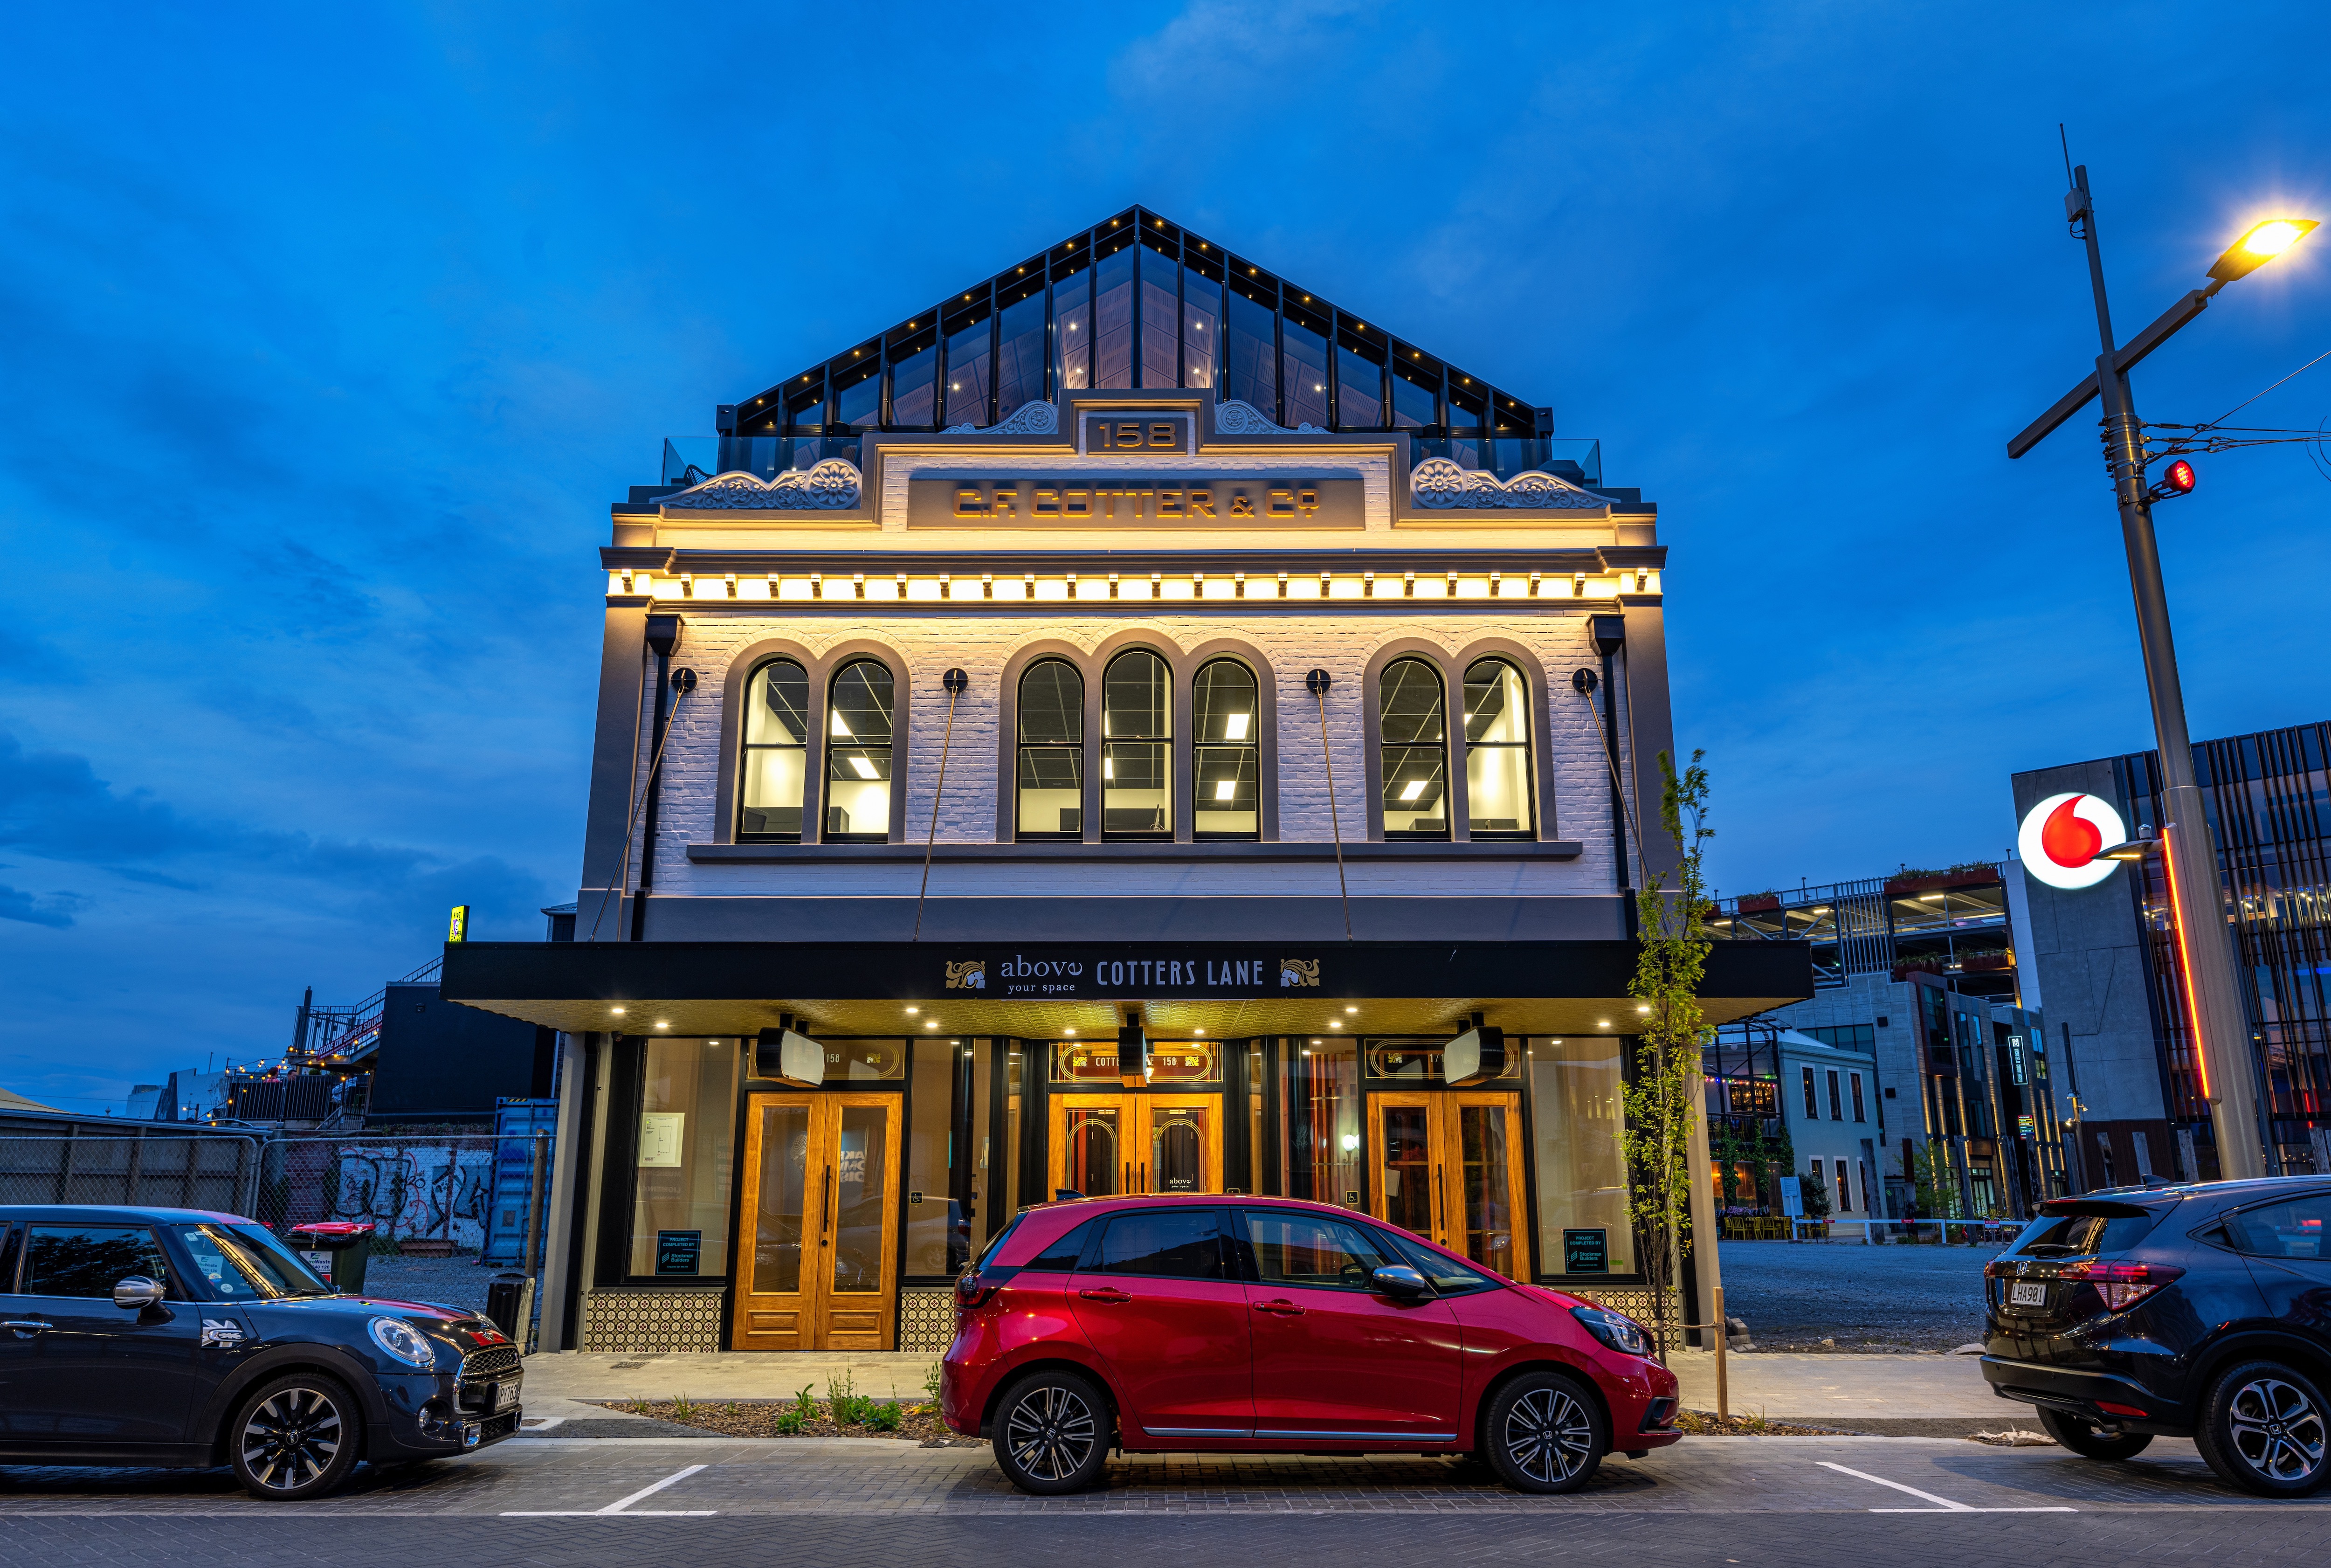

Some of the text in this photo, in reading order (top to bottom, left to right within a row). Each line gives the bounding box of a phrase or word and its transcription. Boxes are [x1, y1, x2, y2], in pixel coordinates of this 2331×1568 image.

[1099, 422, 1176, 447] 158
[953, 489, 1017, 518] C.F.
[1031, 489, 1216, 518] COTTER
[1230, 496, 1255, 518] &
[1001, 954, 1083, 977] above
[1097, 961, 1263, 985] COTTERS LANE
[1008, 984, 1075, 995] your space
[319, 1014, 383, 1056] RIDE ON SUPER SOUND
[826, 1054, 839, 1063] 158
[1096, 1057, 1119, 1066] COTTE
[1163, 1057, 1176, 1066] 158
[2012, 1286, 2042, 1302] LHA901
